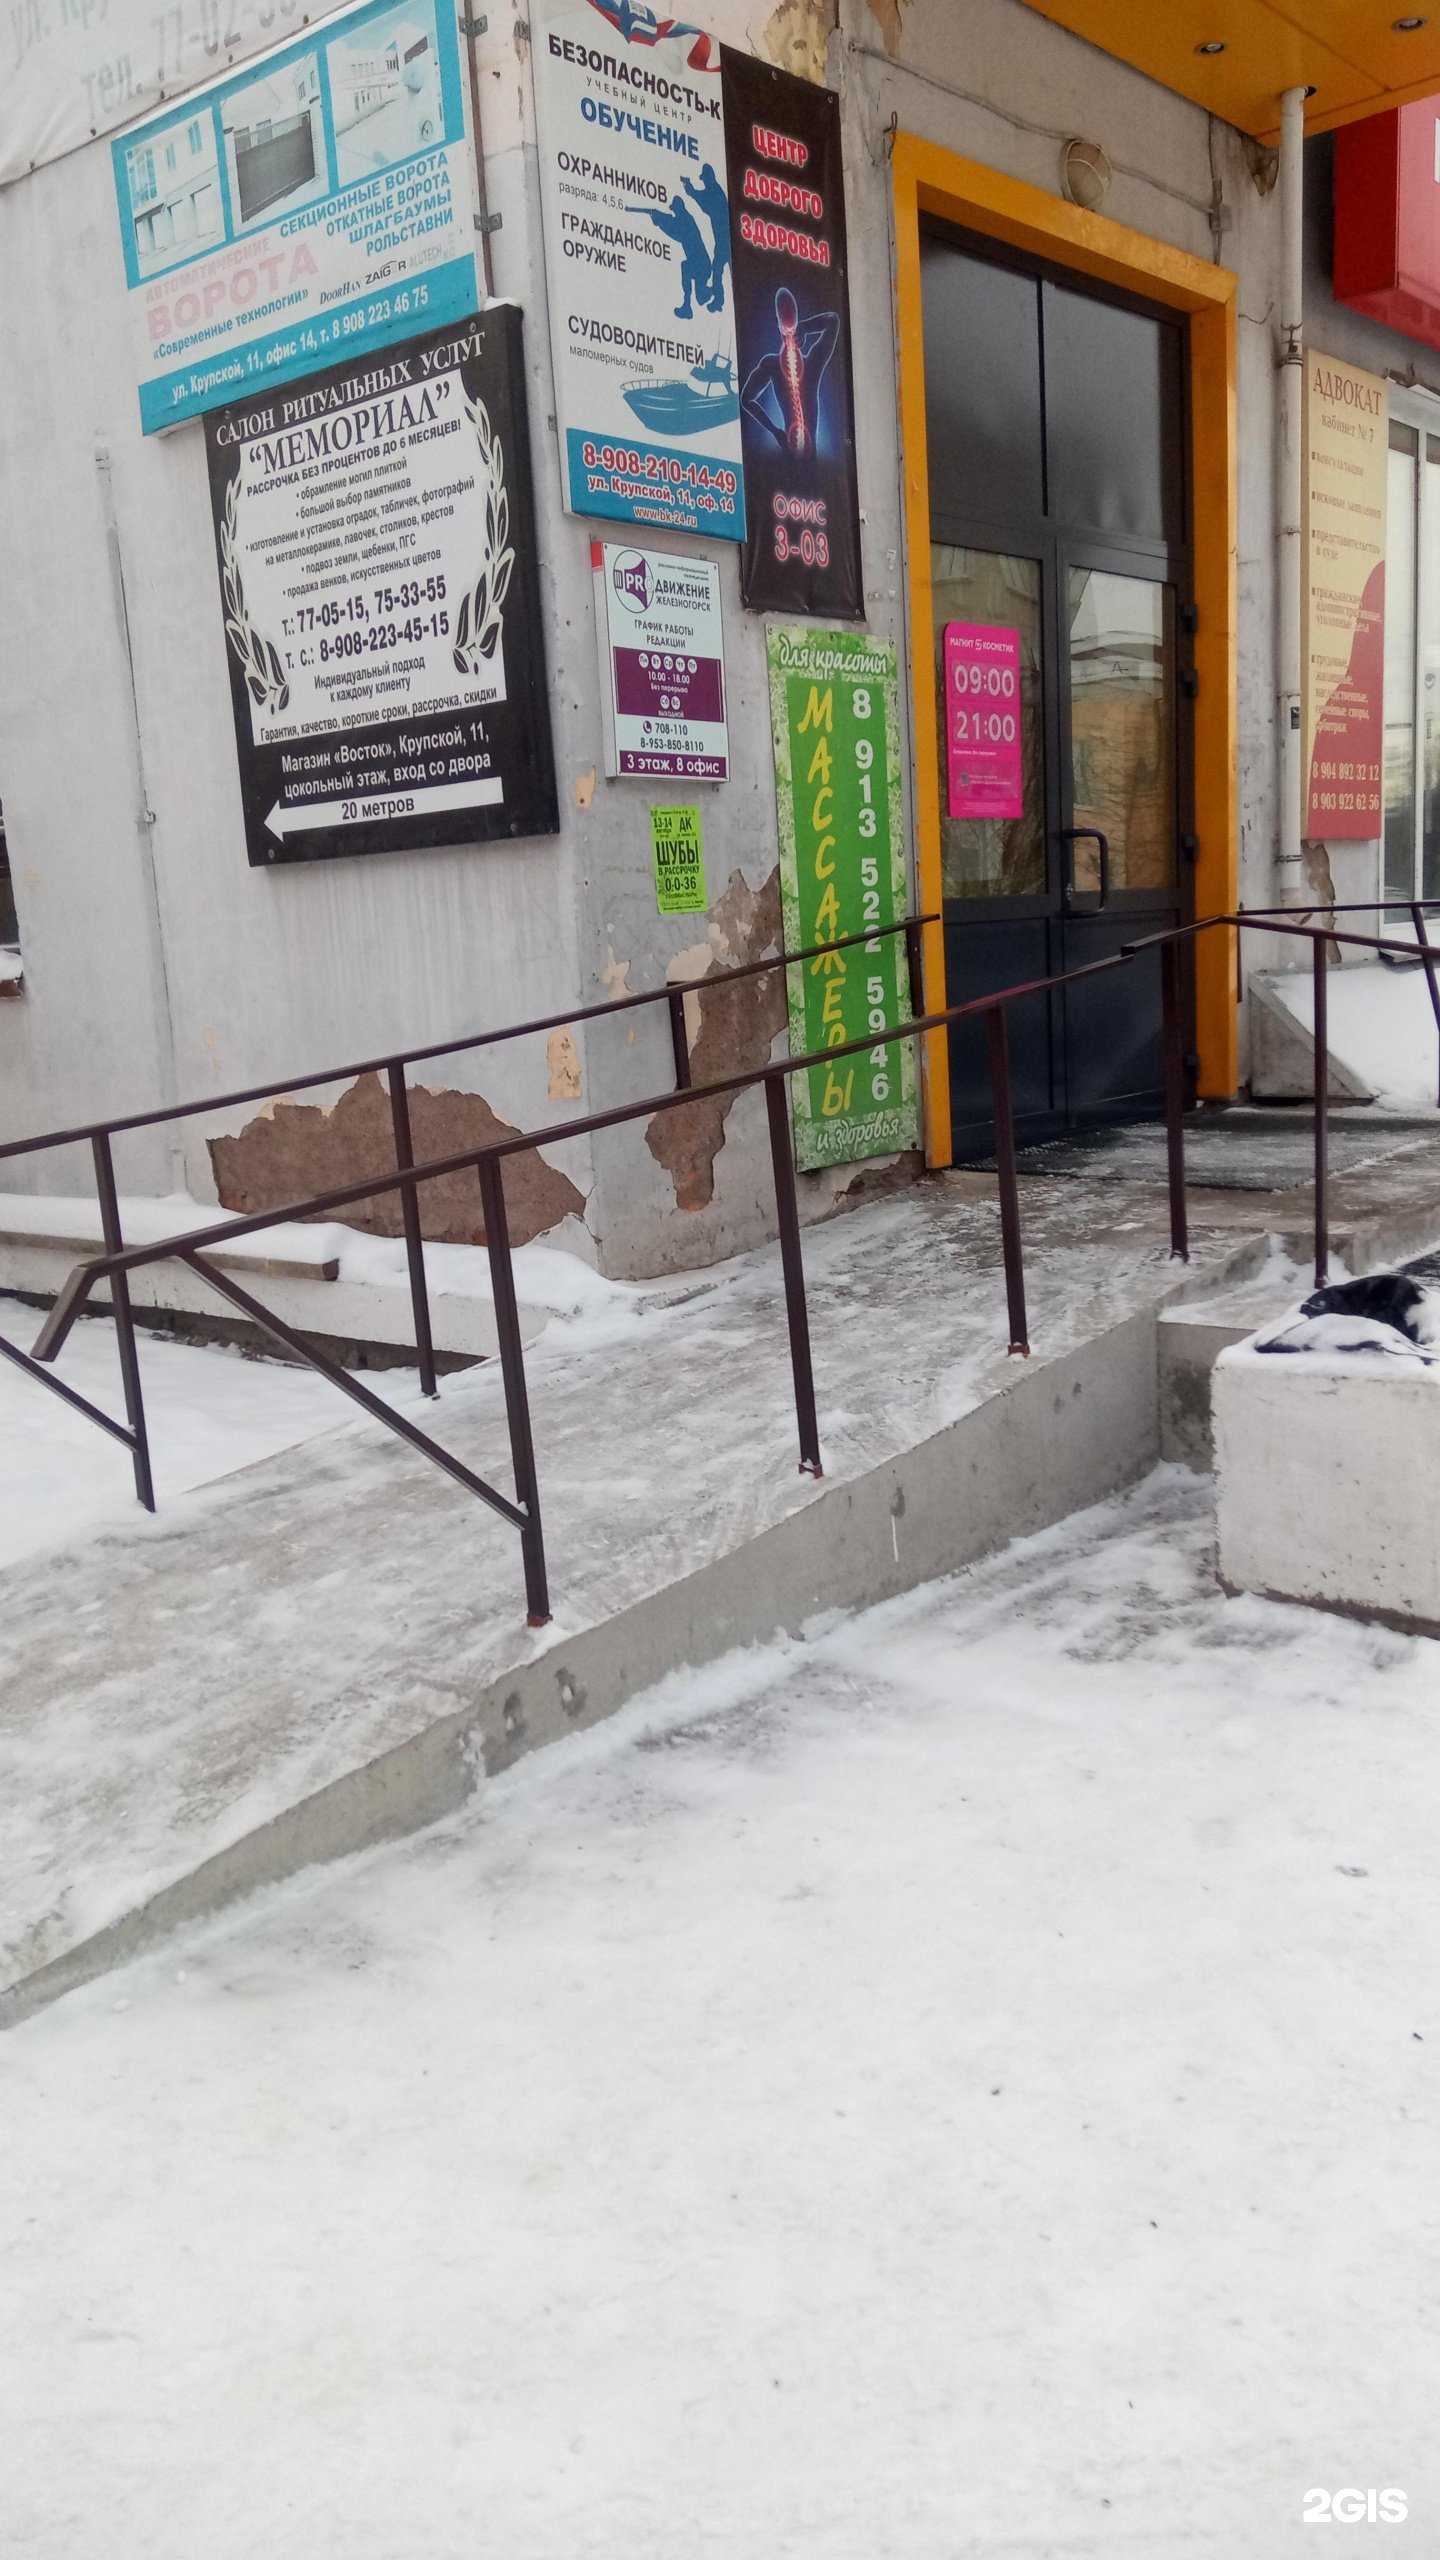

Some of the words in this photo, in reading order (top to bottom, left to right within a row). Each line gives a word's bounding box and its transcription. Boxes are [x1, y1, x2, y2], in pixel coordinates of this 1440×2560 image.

[548, 34, 722, 121] БЕЗОПАСНОСТЬ-К
[585, 75, 646, 109] УЧЕБНЫЙ
[653, 103, 693, 125] ЦЕНТР
[580, 96, 700, 161] ОБУЧЕНИЕ
[752, 125, 809, 167] ЦЕНТР
[280, 180, 381, 238] СЕКЦИОННЫЕ
[385, 151, 449, 191] ВОРОТА
[557, 151, 669, 204] ОХРАННИКОВ
[559, 181, 600, 203] разряда:
[743, 167, 823, 219] ДОБРОГО
[326, 195, 394, 237] ОТКАТНЫЕ
[397, 171, 450, 205] ВОРОТА
[349, 190, 452, 244] ШЛАГБАУМЫ
[366, 208, 453, 256] РОЛЬСТАВНИ
[561, 212, 672, 262] ГРАЖДАНСКОЕ
[563, 239, 627, 273] ОРУЖИЕ
[740, 214, 831, 267] ЗДОРОВЬЯ
[145, 243, 320, 341] ВОРОТА
[153, 320, 234, 361] «Современные
[236, 288, 310, 328] технологии»
[171, 386, 188, 405] ул.
[190, 360, 245, 394] Крупской,
[246, 351, 263, 372] 11,
[266, 339, 297, 366] офис
[300, 329, 317, 350] 14,
[332, 321, 340, 339] 8
[343, 309, 365, 334] 908
[368, 300, 391, 326] 223
[394, 294, 409, 314] 46
[411, 284, 428, 306] 75
[568, 315, 706, 366] СУДОВОДИТЕЛЕЙ
[569, 344, 628, 369] маломерных
[629, 357, 654, 374] судов
[216, 407, 275, 446] САЛОН
[282, 360, 412, 423] РИТУАЛЬНЫХ
[420, 332, 486, 377] УСЛУГ
[1312, 367, 1382, 416] АДВОКАТ
[246, 472, 300, 498] РАССРОЧКА
[301, 463, 320, 481] БЕЗ
[321, 446, 381, 476] ПРОЦЕНТОВ
[382, 440, 398, 458] ДО
[399, 437, 407, 450] 6
[408, 419, 462, 448] МЕСЯЦЕВ!
[300, 475, 347, 500] обрамление
[348, 470, 373, 486] могил
[374, 456, 408, 479] плиткой
[583, 441, 737, 495] 8-908-210-14-49
[249, 530, 299, 553] изготовление
[306, 517, 345, 540] установка
[346, 507, 380, 527] оградок,
[381, 496, 420, 516] табличек,
[422, 475, 475, 505] фотографий
[299, 498, 336, 520] большой
[336, 491, 363, 509] выбор
[363, 478, 412, 501] памятников
[588, 475, 609, 492] ул.
[611, 476, 675, 505] Крупской,
[677, 489, 696, 508] 11,
[697, 496, 719, 513] оф.
[720, 498, 735, 513] 14
[773, 494, 827, 526] ОФИС
[265, 556, 275, 567] на
[276, 537, 344, 564] металлокерамике,
[344, 527, 379, 546] лавочек,
[380, 515, 420, 536] столиков,
[421, 504, 455, 525] крестов
[305, 560, 333, 575] подвоз
[334, 550, 361, 568] земли,
[361, 541, 398, 560] щебенки,
[399, 533, 416, 550] ПГС
[775, 525, 829, 567] 3-03
[287, 581, 319, 599] продажа
[320, 573, 350, 591] венков,
[350, 556, 411, 584] искусственных
[412, 549, 442, 566] цветов
[655, 579, 710, 600] ДВИЖЕНИЕ
[297, 595, 370, 634] 77-05-15,
[374, 574, 447, 616] 75-33-55
[634, 619, 662, 633] ГРАФИК
[665, 624, 694, 637] РАБОТЫ
[656, 596, 711, 612] ЖЕЛЕЗНОГОРСК
[319, 611, 450, 663] 8-908-223-45-15
[646, 635, 686, 648] РЕДАКЦИИ
[779, 633, 809, 667] для
[816, 650, 887, 681] красоты
[314, 659, 390, 690] Индивидуальный
[392, 655, 426, 677] подход
[336, 684, 374, 704] каждому
[375, 676, 412, 697] клиенту
[955, 665, 1015, 697] 09:00
[260, 724, 300, 742] Гарантия,
[301, 717, 340, 736] качество,
[341, 709, 380, 729] короткие
[381, 704, 411, 723] сроки,
[412, 694, 462, 717] рассрочка,
[463, 686, 498, 706] скидки
[655, 723, 688, 735] 708-110
[956, 711, 1015, 742] 21:00
[281, 752, 331, 774] Магазин
[334, 742, 397, 766] «Восток»,
[398, 726, 467, 756] Крупской,
[469, 720, 490, 745] 11,
[627, 753, 635, 769] 3
[638, 758, 674, 773] этаж,
[676, 757, 684, 772] 8
[687, 758, 720, 775] офис
[640, 738, 704, 752] 8-953-850-8110
[284, 770, 354, 801] цокольный
[356, 768, 391, 789] этаж,
[393, 762, 427, 784] вход
[428, 759, 446, 776] со
[448, 753, 492, 777] двора
[1312, 761, 1319, 778] 8
[1369, 764, 1379, 781] 12
[342, 802, 358, 821] 20
[361, 796, 415, 820] метров
[1312, 792, 1319, 809] 8
[656, 840, 700, 866] ШУБЫ
[816, 1133, 831, 1151] и
[834, 1111, 899, 1151] здоровья
